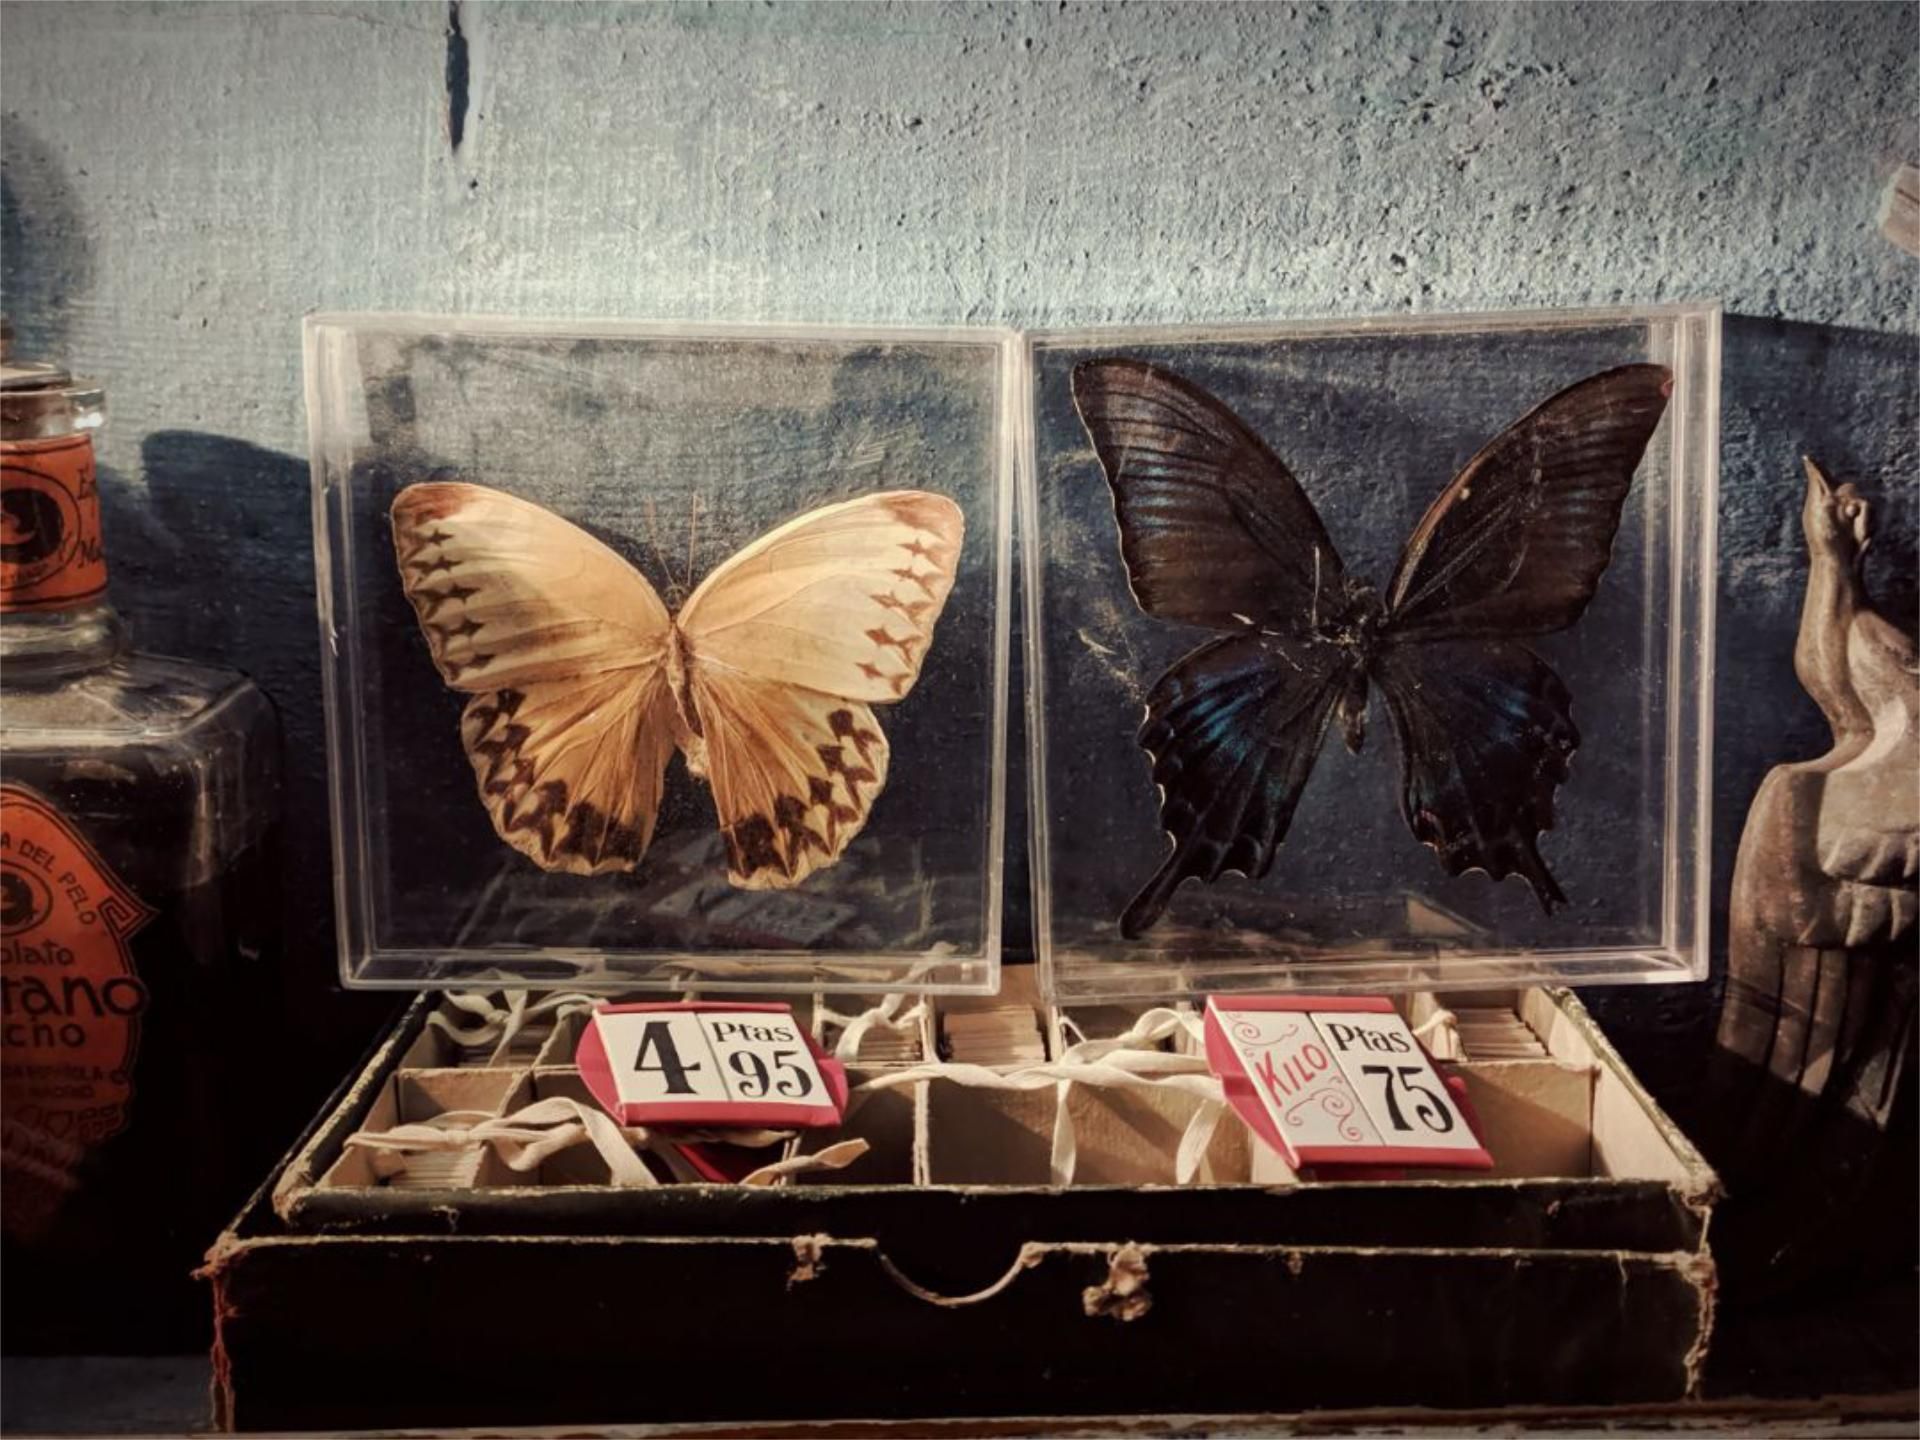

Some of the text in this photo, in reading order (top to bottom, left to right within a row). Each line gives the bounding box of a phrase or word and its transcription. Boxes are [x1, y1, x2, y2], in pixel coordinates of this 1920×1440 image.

[18, 839, 56, 873] DEL
[58, 872, 97, 926] PELO
[633, 1021, 701, 1094] 4
[712, 1022, 794, 1042] Ptas
[1327, 1023, 1411, 1053] Ptas
[729, 1050, 812, 1098] 95
[1255, 1044, 1328, 1107] KILO
[1362, 1065, 1454, 1133] 75
